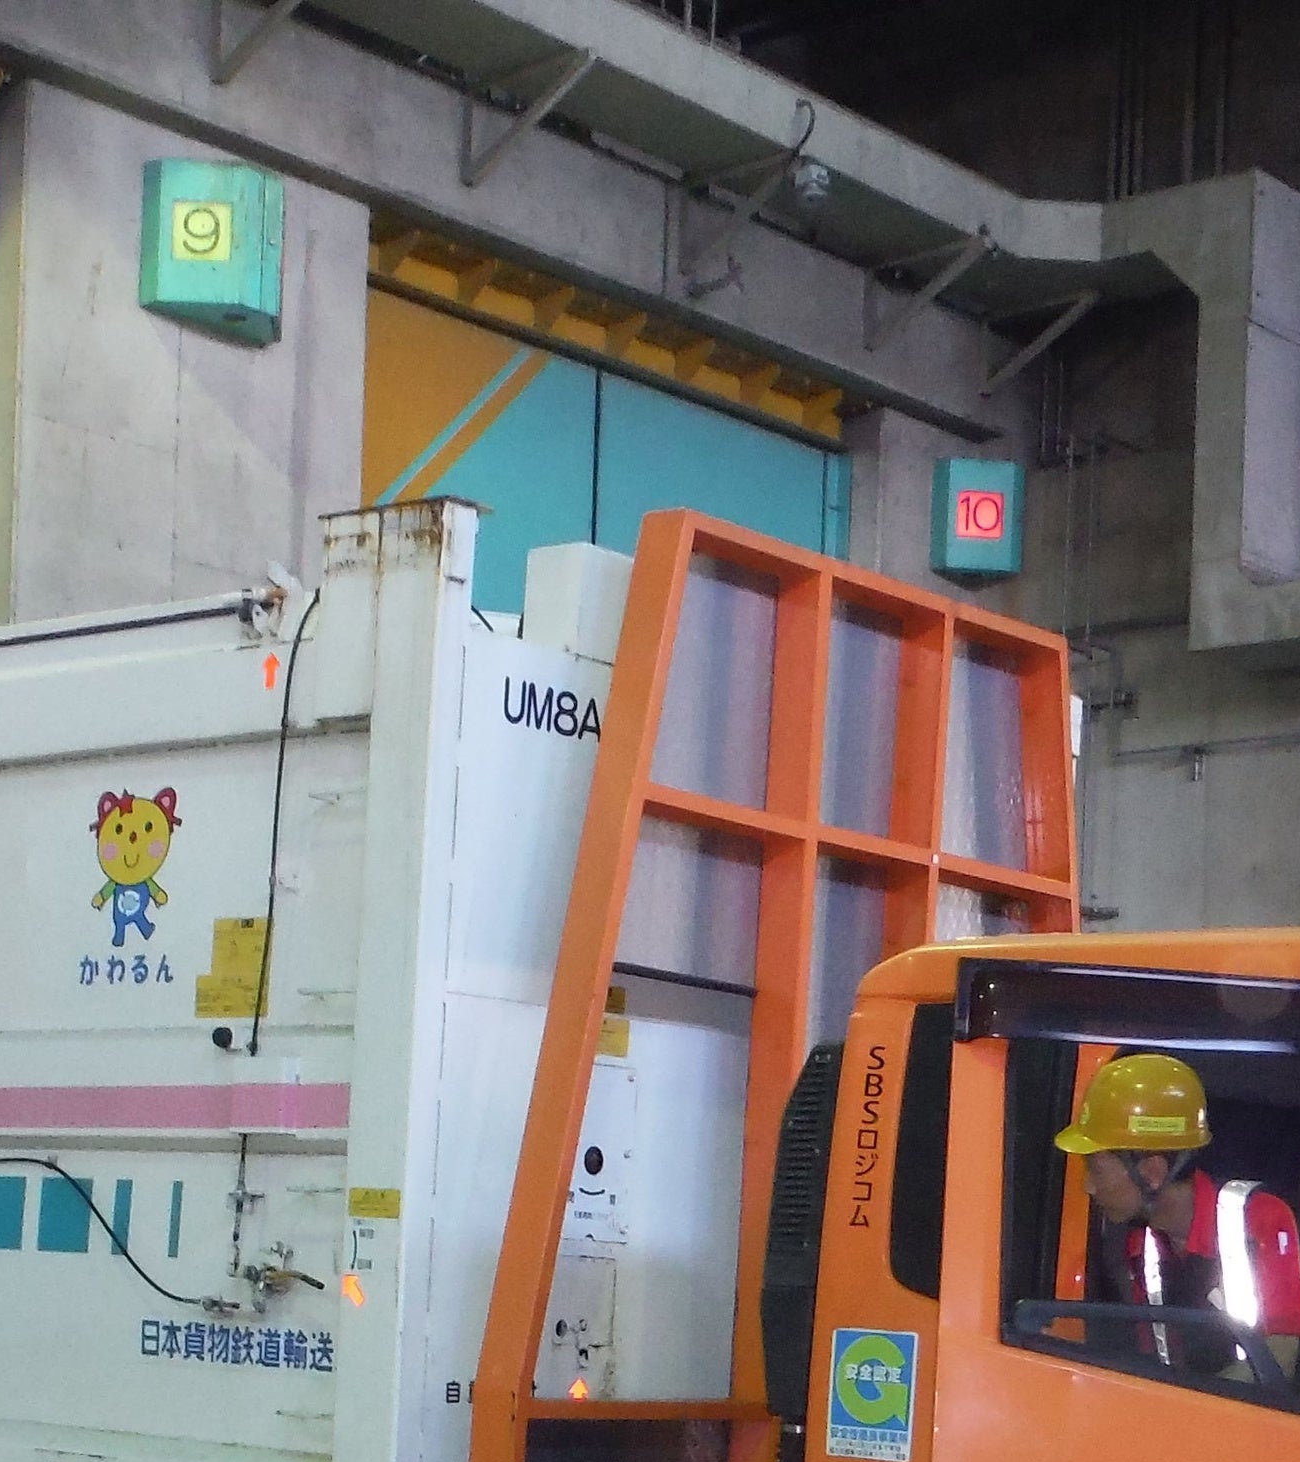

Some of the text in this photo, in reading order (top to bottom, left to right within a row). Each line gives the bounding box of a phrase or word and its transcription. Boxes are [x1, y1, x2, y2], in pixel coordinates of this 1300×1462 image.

[182, 207, 220, 255] 9
[960, 496, 1000, 531] 10
[503, 675, 602, 743] UM8A
[80, 953, 174, 986] かわるん
[141, 1319, 335, 1373] 日本貨物鉄道輸送
